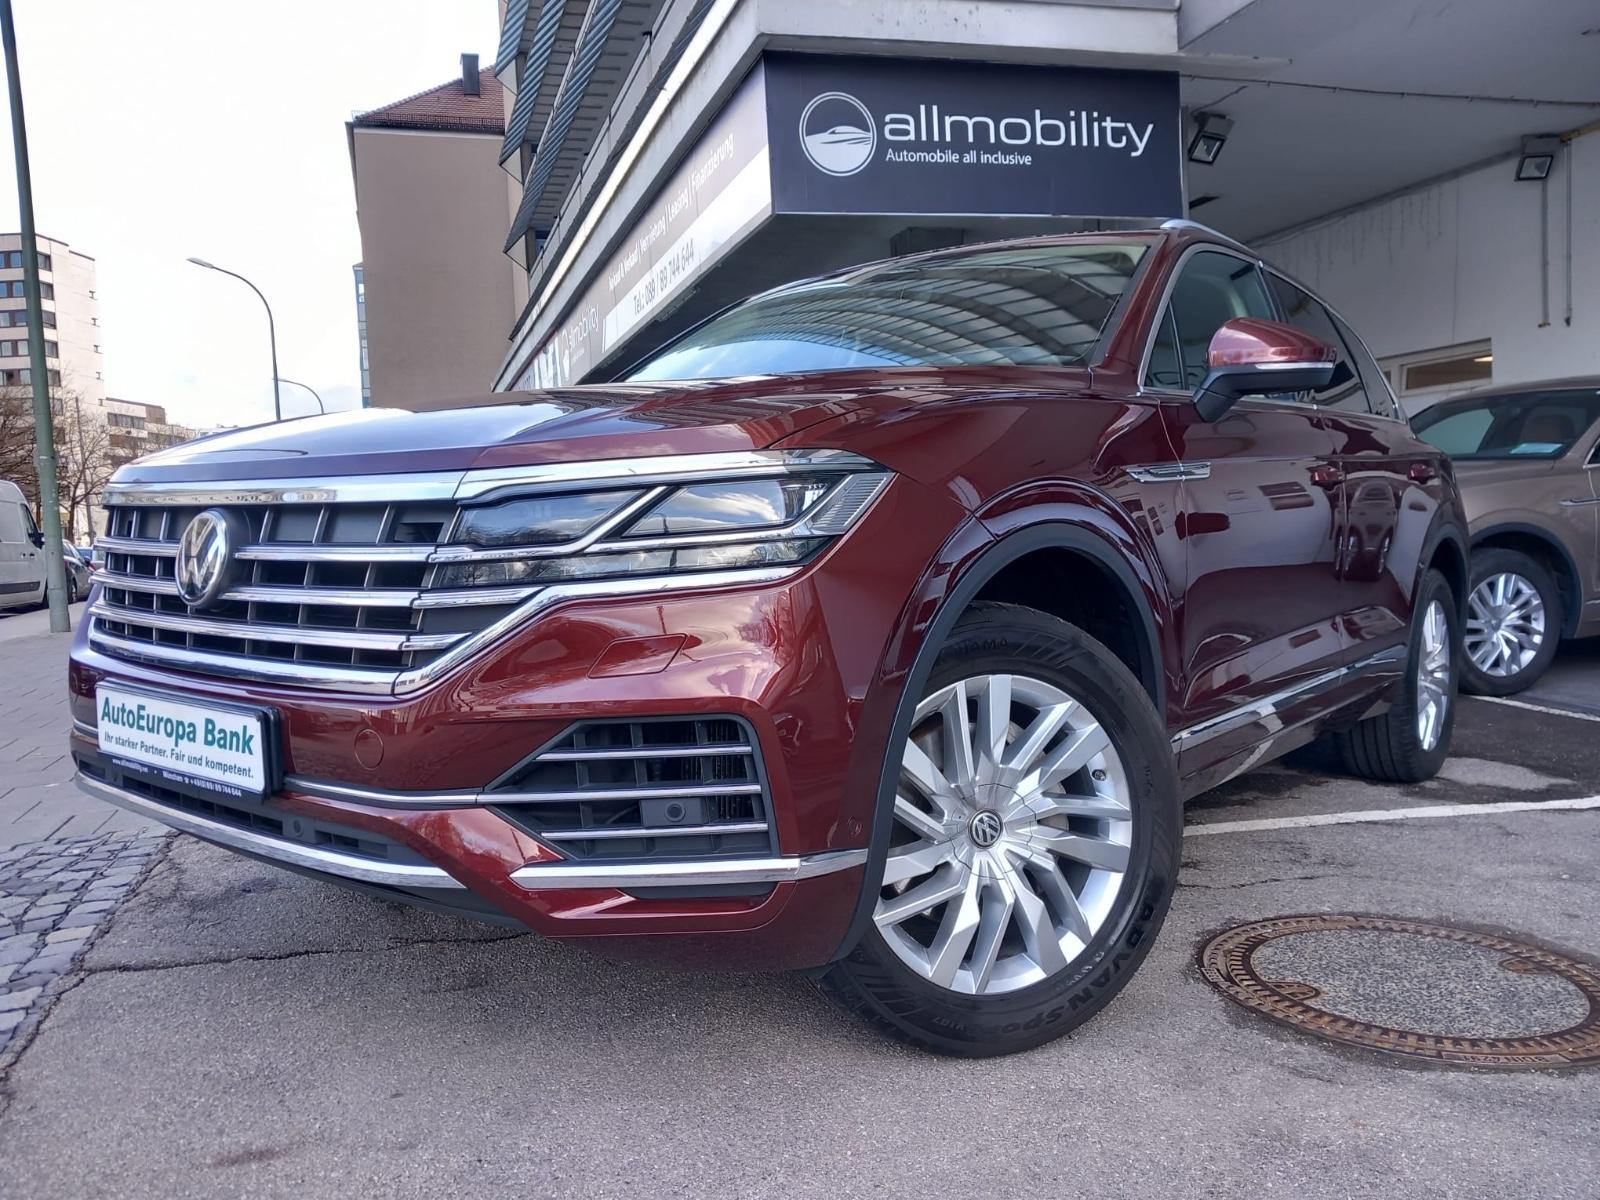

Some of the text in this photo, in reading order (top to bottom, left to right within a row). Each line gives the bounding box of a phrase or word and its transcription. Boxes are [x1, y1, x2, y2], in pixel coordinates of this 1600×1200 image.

[884, 104, 1154, 157] allmobility
[886, 148, 1032, 166] Automobile all inclusive
[668, 189, 688, 223] Leasing
[692, 132, 734, 196] Finanzierung
[660, 265, 668, 293] 89
[669, 253, 680, 284] 744
[681, 237, 694, 272] 644
[101, 696, 254, 756] AutoEuropa Bank
[105, 731, 254, 779] Ihr starker Partner. Fair und kompetent.
